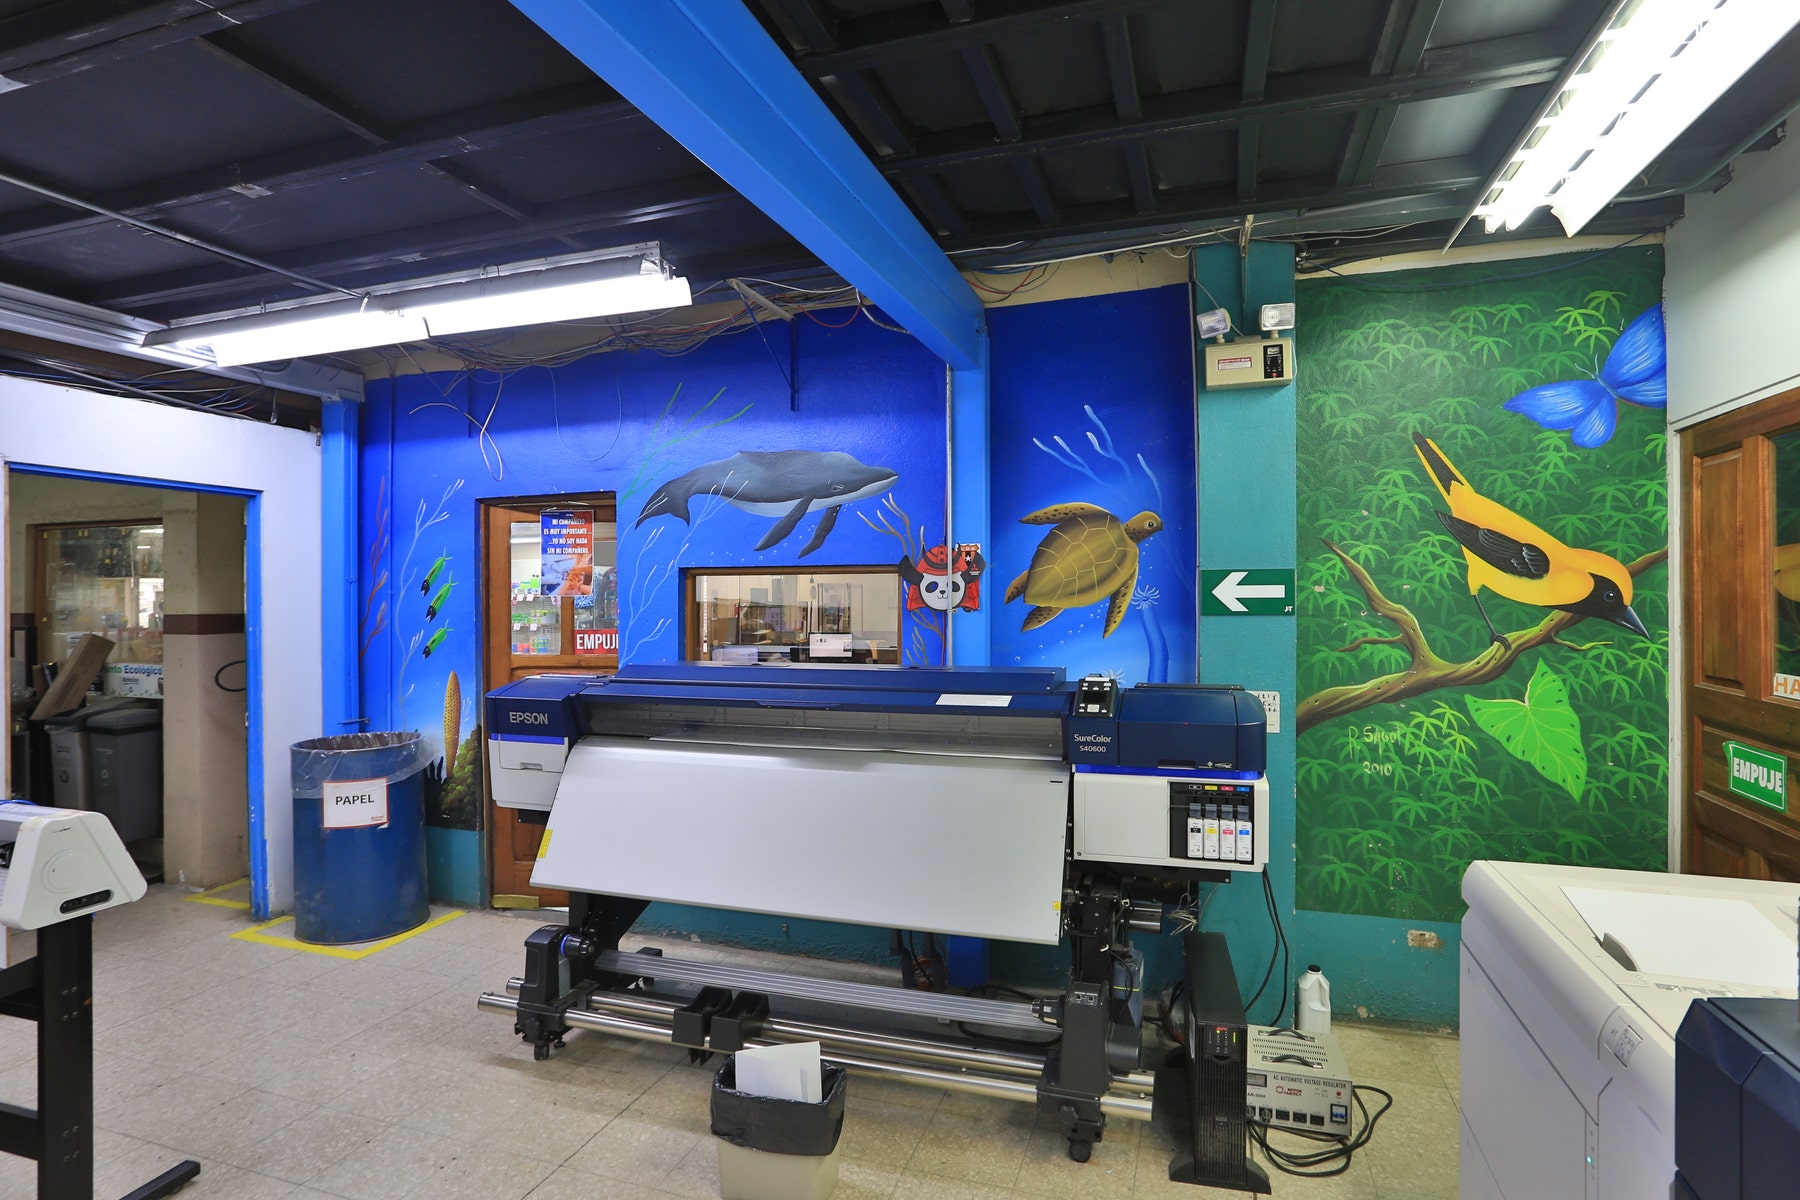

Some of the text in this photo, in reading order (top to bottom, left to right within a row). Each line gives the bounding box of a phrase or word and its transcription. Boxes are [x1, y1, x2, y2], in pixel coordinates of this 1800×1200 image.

[509, 711, 549, 725] EPSON
[1074, 734, 1112, 743] SureColor
[1363, 761, 1392, 776] 2010
[1733, 757, 1783, 793] EMPUJE
[335, 794, 375, 805] PAPEL
[1323, 1081, 1347, 1089] REGULATOR
